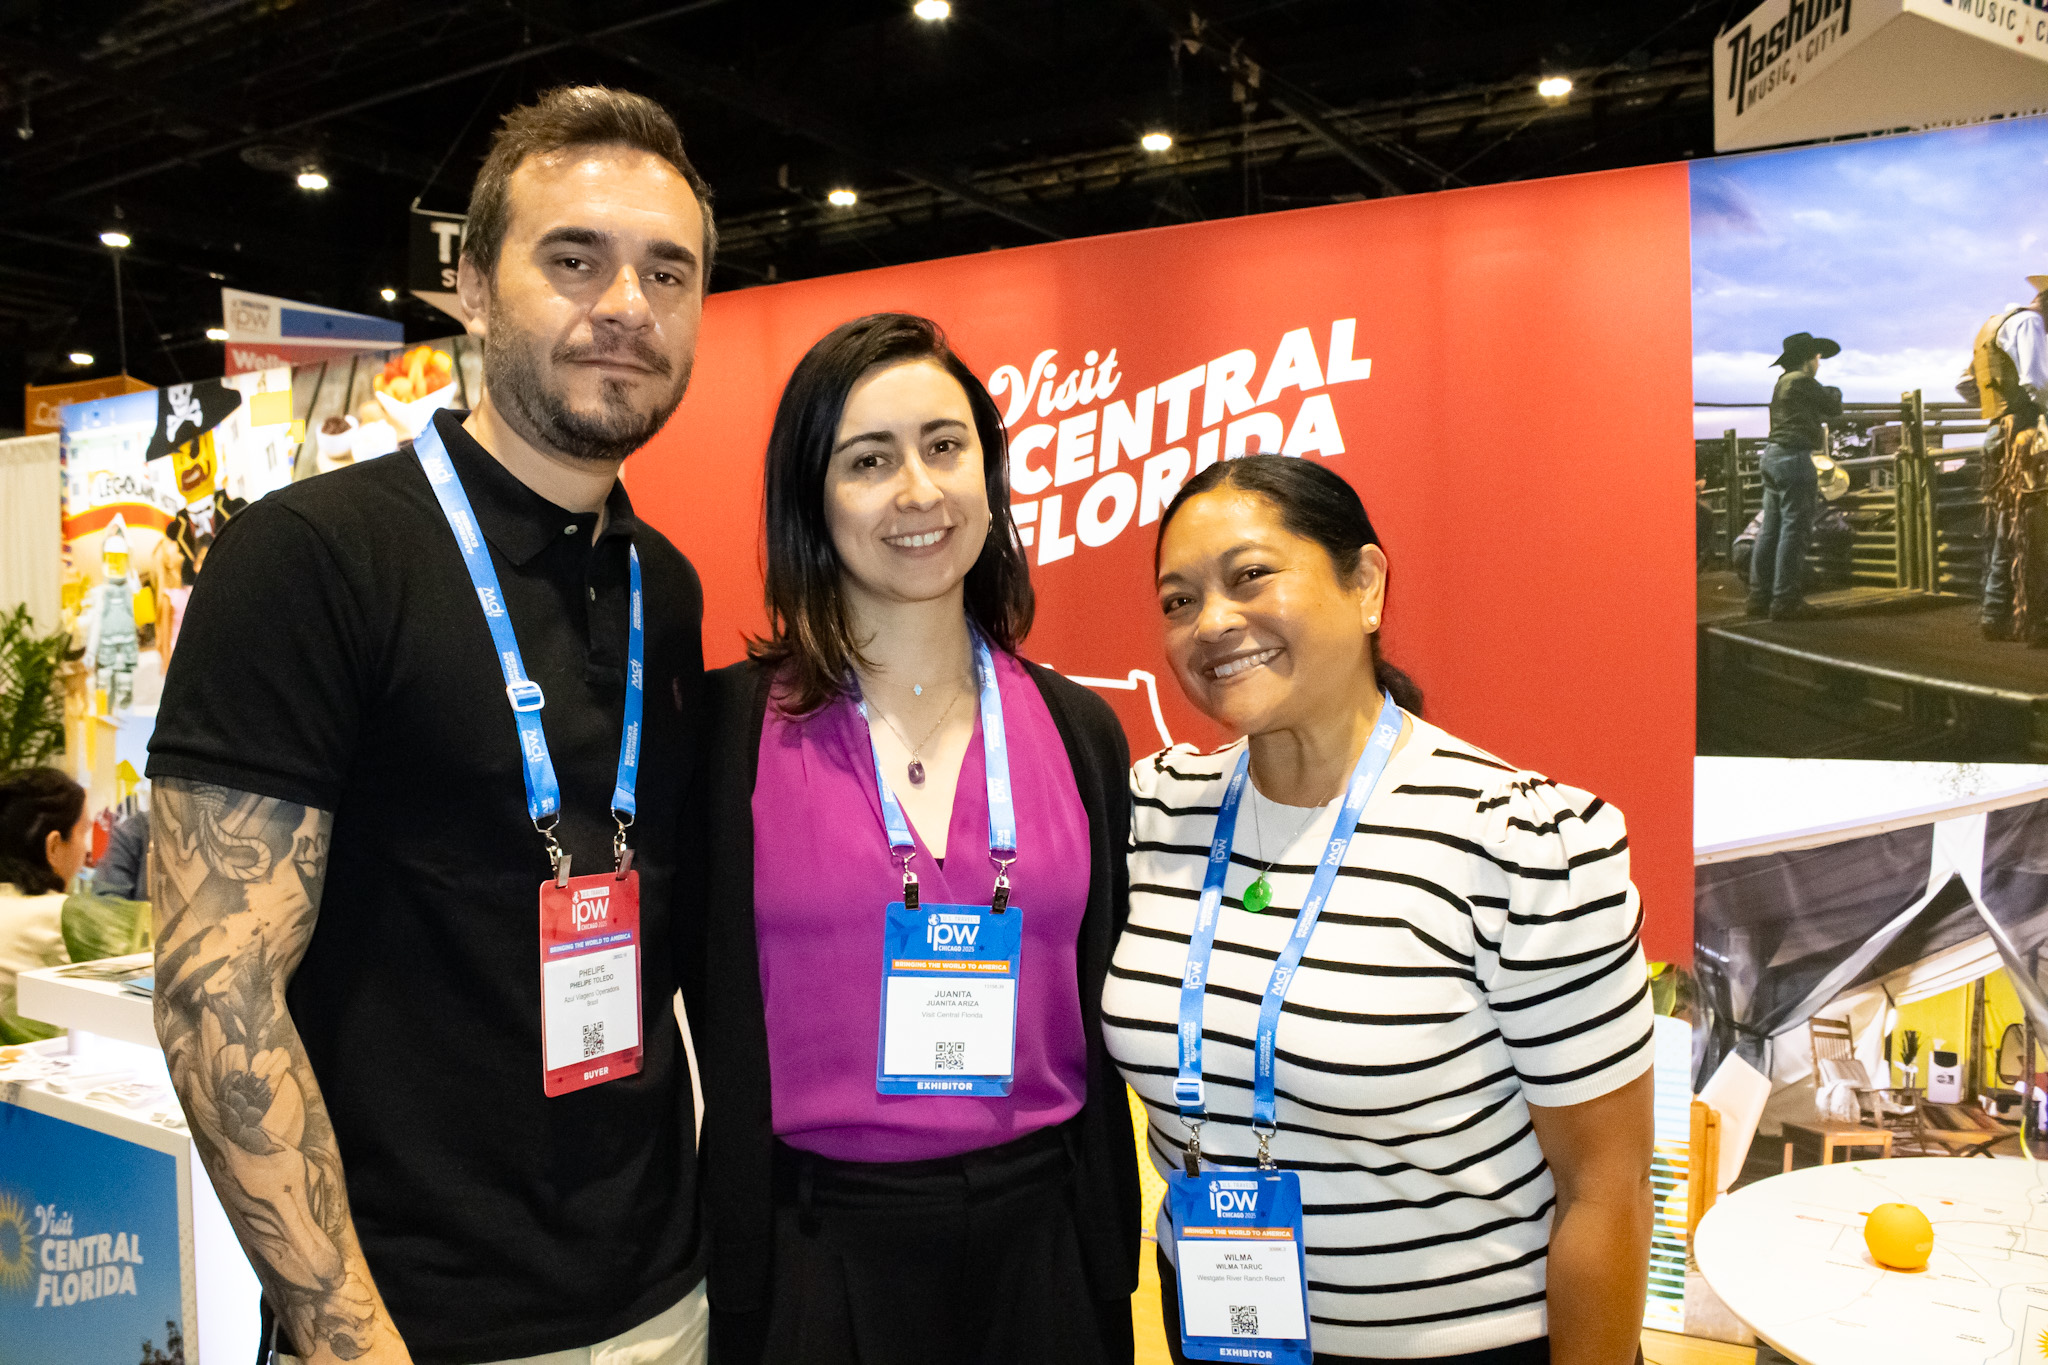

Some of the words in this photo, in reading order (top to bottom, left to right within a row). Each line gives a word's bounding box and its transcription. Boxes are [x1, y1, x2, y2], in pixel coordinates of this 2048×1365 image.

[1747, 58, 1792, 107] MUSIC
[1805, 19, 1840, 63] CITY
[988, 348, 1122, 427] Visit
[1009, 317, 1372, 495] CENTRAL
[1215, 838, 1227, 863] ipw
[1325, 838, 1342, 865] ipw
[572, 896, 609, 931] ipw
[549, 943, 574, 954] BRINGING
[574, 941, 585, 949] THE
[585, 938, 602, 947] WORLD
[610, 933, 631, 942] AMERICA
[927, 923, 979, 951] ipw
[569, 979, 592, 990] PHELIPE
[593, 973, 614, 984] TOLEDO
[578, 964, 605, 978] PHELIPE
[1271, 967, 1288, 995] ipw
[934, 990, 972, 998] JUANITA
[937, 1011, 960, 1019] Central
[583, 1066, 609, 1081] BUYER
[916, 1082, 973, 1091] EXHIBITOR
[1209, 1190, 1258, 1218] ipw
[1222, 1211, 1244, 1219] CHICAGO
[34, 1204, 74, 1236] Visit
[1262, 1230, 1291, 1238] AMERICA
[40, 1231, 144, 1273] CENTRAL
[1224, 1253, 1253, 1261] WILMA
[35, 1265, 138, 1308] FLORIDA
[1197, 1274, 1225, 1282] Westgate
[1219, 1348, 1273, 1360] EXHIBITOR
